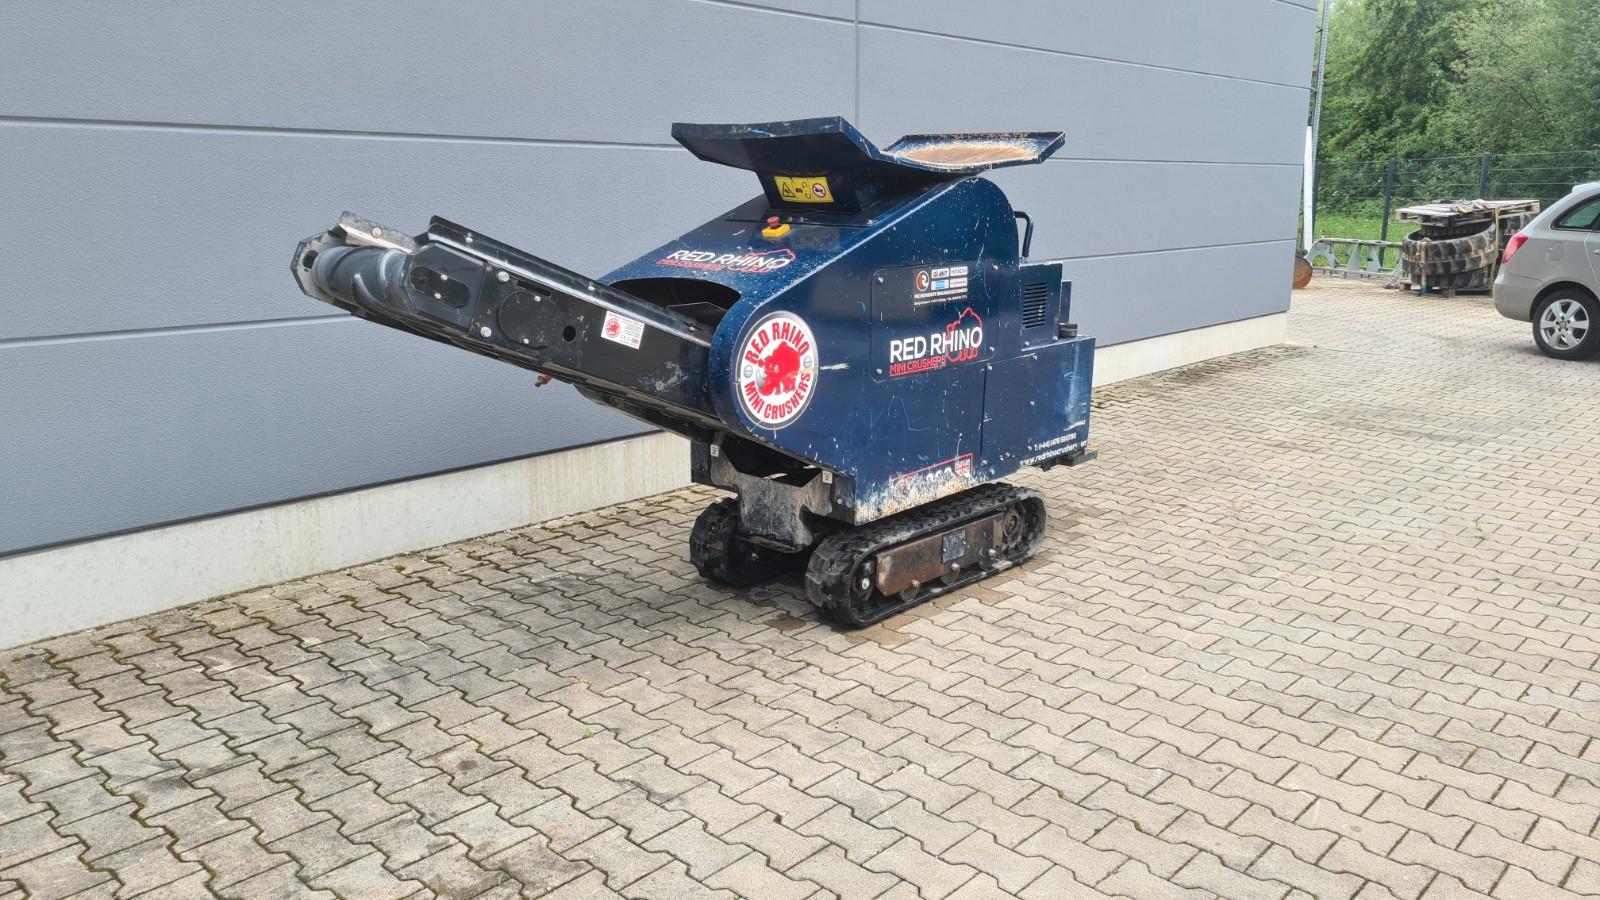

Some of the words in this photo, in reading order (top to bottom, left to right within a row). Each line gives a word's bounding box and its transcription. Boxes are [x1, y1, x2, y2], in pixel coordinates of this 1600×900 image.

[666, 250, 715, 262] RED
[712, 254, 790, 269] RHINO
[745, 329, 769, 364] RED
[772, 322, 809, 356] RHINO
[890, 336, 927, 363] RED
[930, 326, 983, 356] RHINO
[889, 362, 906, 374] MINI
[906, 355, 947, 371] CRUSHERS
[744, 381, 765, 413] MINI
[763, 373, 810, 420] CRUSHERS
